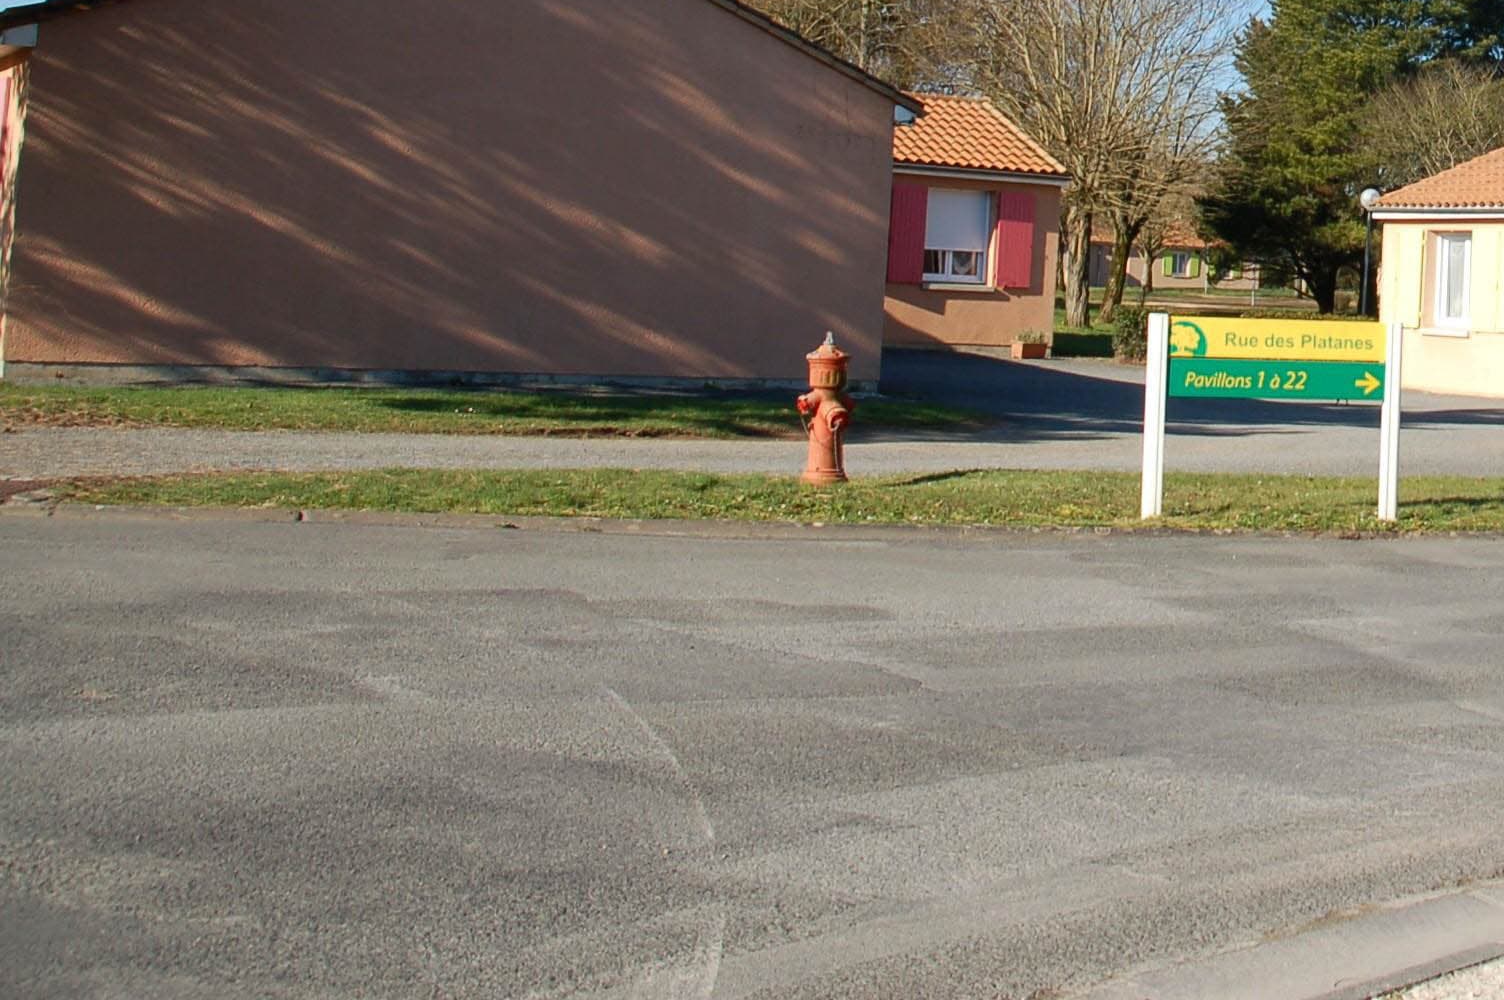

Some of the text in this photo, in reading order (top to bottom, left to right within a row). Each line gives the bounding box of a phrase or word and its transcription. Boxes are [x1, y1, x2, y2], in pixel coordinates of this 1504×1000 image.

[1224, 331, 1374, 350] Rue des Platanes
[1185, 371, 1308, 390] Pavillons 1 à 22
